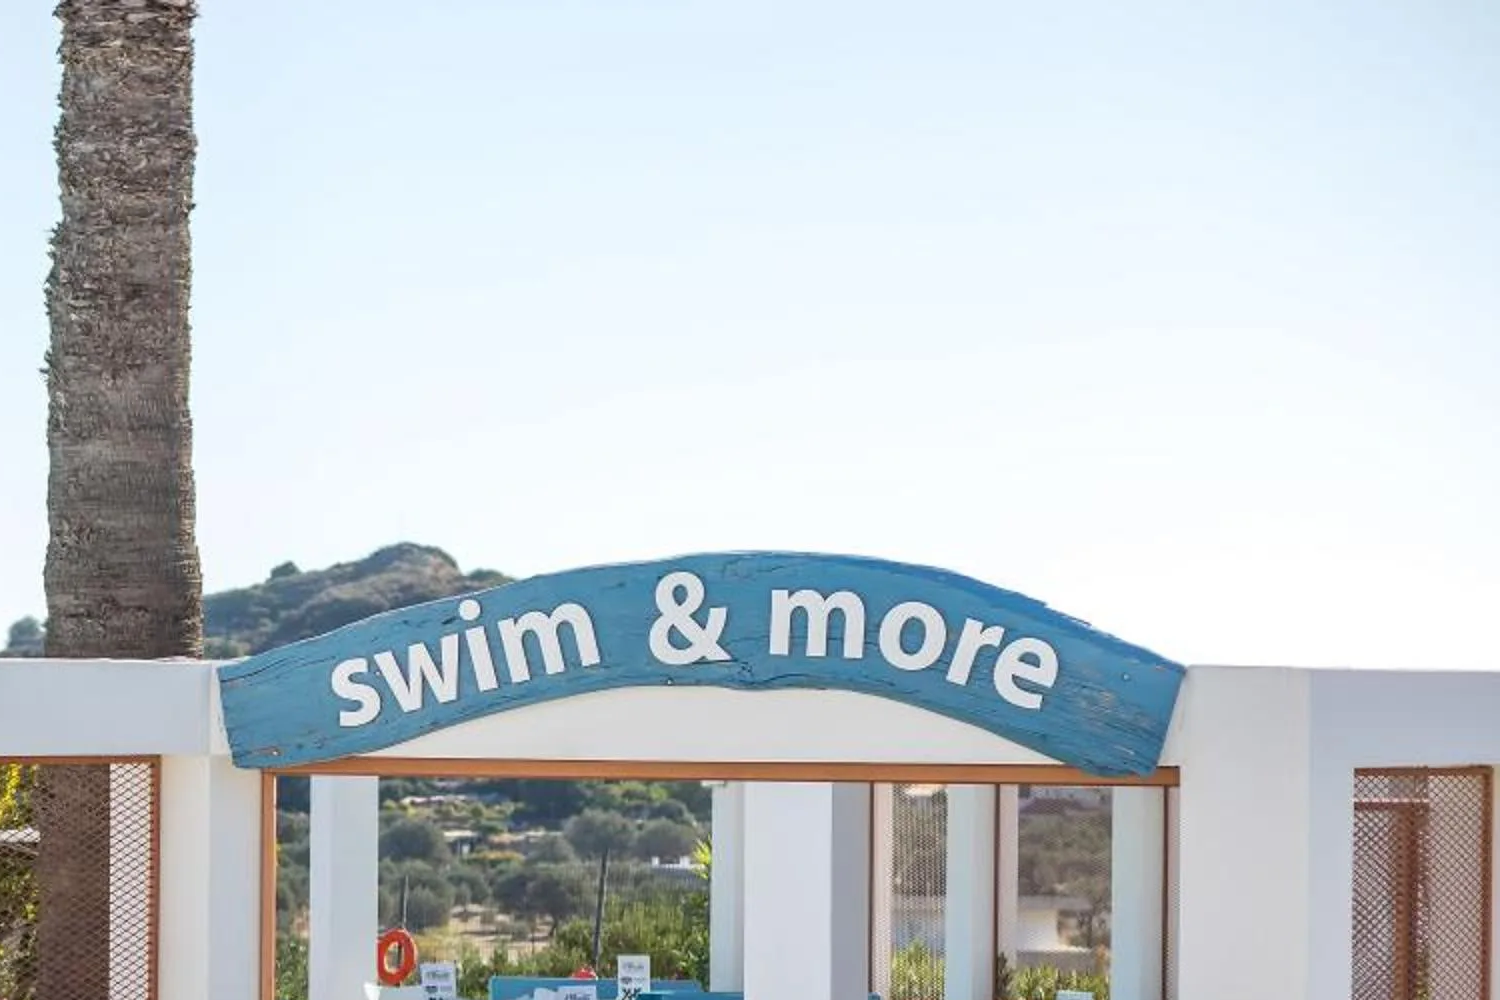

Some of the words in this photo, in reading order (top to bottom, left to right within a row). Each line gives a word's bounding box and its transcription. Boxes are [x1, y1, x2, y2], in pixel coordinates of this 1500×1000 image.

[331, 599, 600, 727] swim
[649, 571, 732, 665] &
[769, 589, 1059, 710] more
